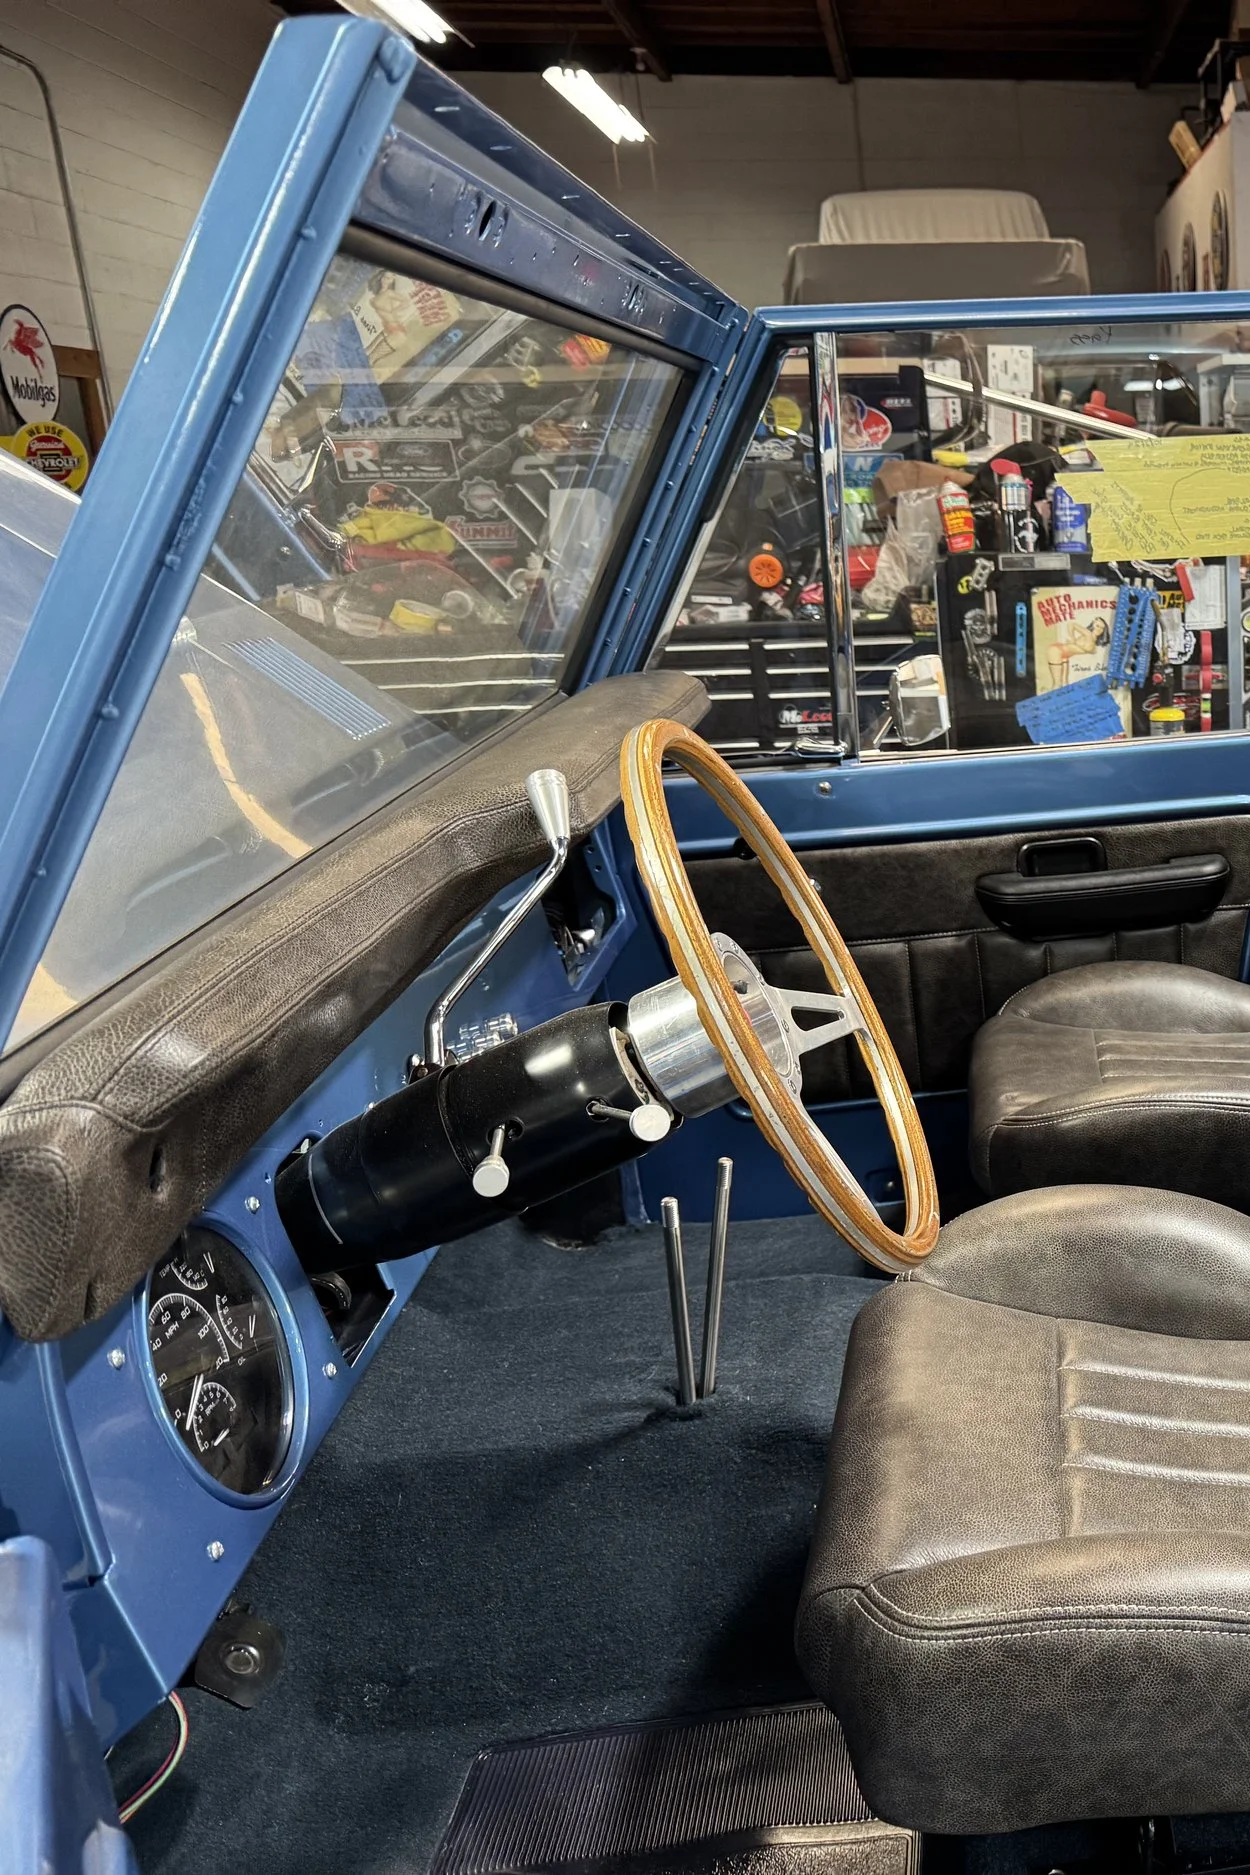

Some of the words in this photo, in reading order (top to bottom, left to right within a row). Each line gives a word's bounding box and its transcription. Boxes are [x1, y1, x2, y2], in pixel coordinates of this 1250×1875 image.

[10, 375, 56, 407] Mobilgas
[26, 426, 42, 438] WE
[44, 425, 64, 437] USE
[1037, 594, 1072, 610] AUTO
[1040, 600, 1117, 618] MECHANICS
[1044, 610, 1075, 628] MATE
[161, 1311, 171, 1325] 60
[180, 1306, 191, 1320] 80
[165, 1321, 180, 1339] MPH
[198, 1324, 210, 1340] 100
[152, 1338, 162, 1351] 40
[157, 1373, 168, 1387] 20
